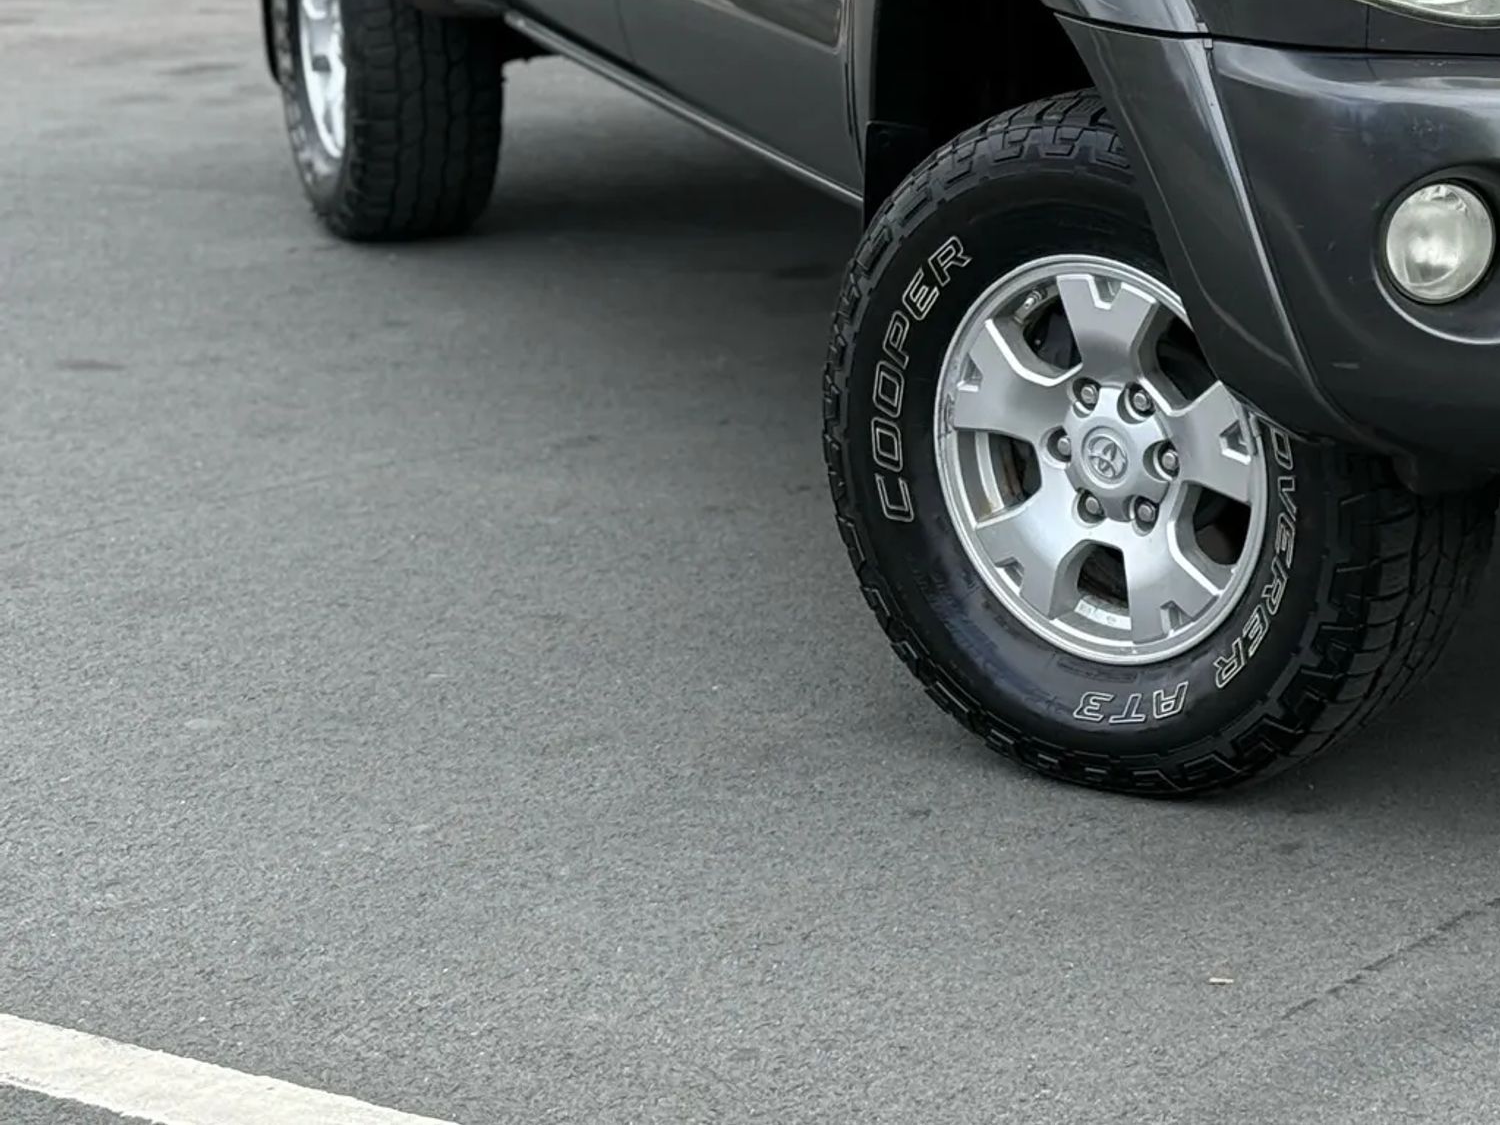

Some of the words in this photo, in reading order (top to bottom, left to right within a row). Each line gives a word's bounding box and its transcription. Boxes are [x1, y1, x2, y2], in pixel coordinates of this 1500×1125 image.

[871, 236, 972, 522] COOPER
[1213, 426, 1297, 689] OVERER
[1073, 681, 1189, 725] AT3
